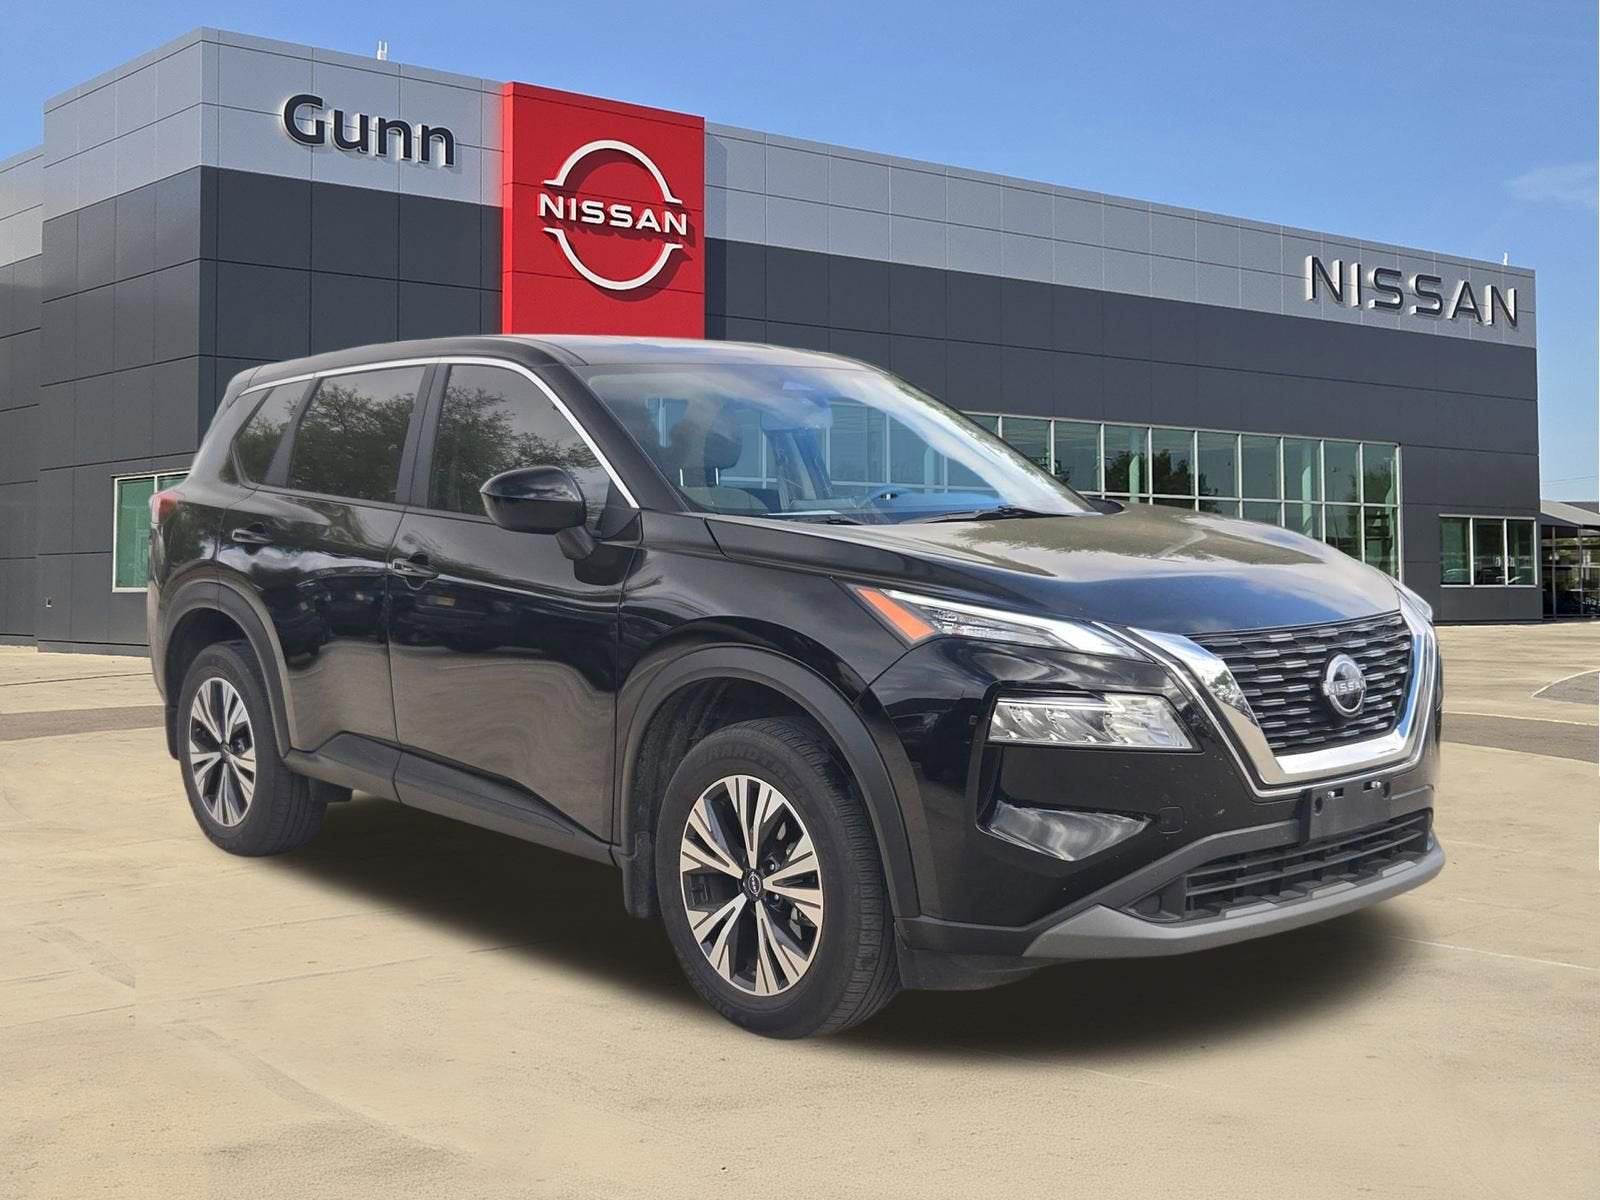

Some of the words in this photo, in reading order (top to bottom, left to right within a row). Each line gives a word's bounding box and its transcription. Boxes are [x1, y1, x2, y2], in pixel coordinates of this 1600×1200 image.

[282, 95, 454, 167] Gunn
[538, 192, 688, 236] NISSAN
[1305, 255, 1517, 327] NISSAN
[1325, 680, 1366, 695] NISSAN
